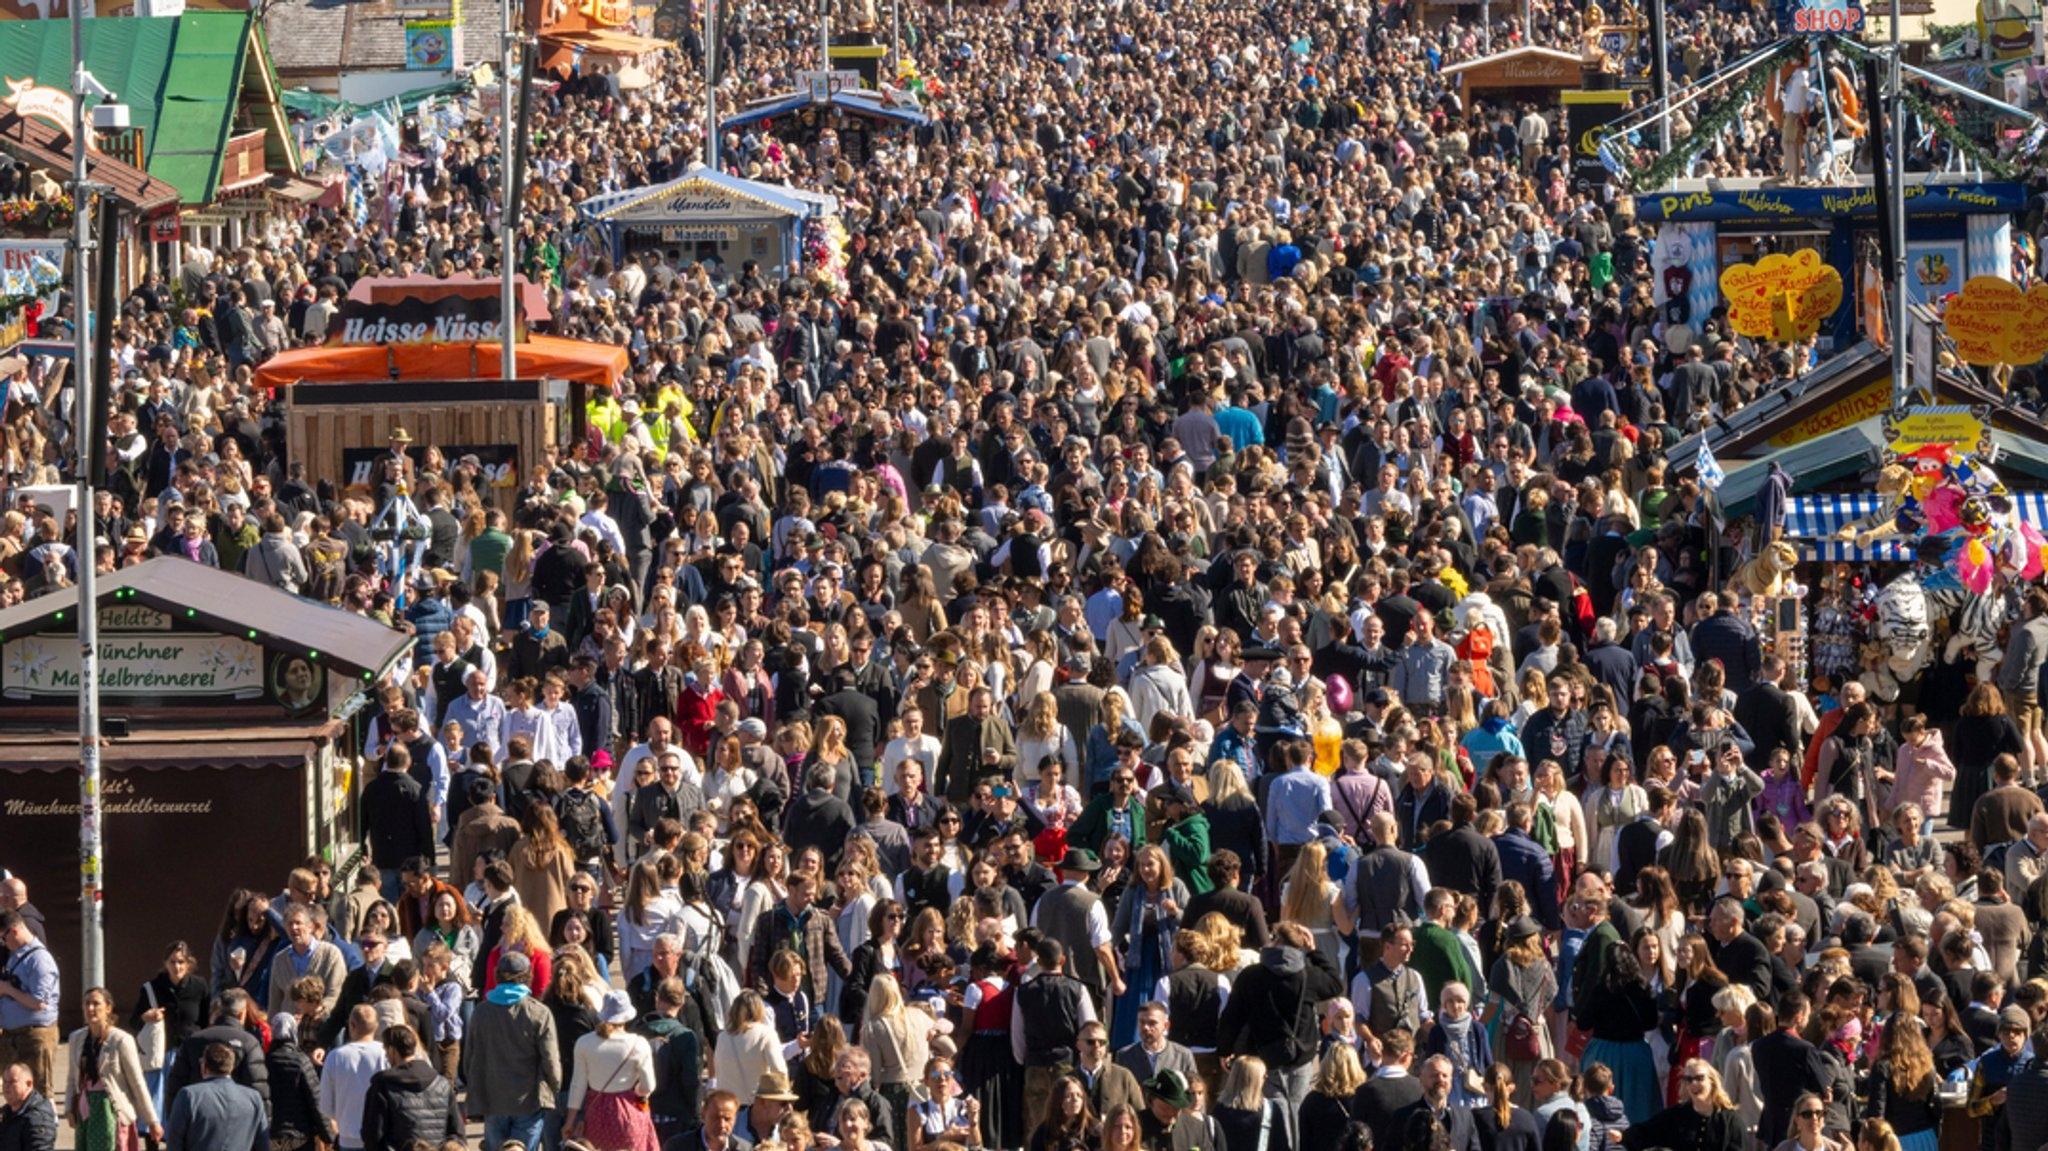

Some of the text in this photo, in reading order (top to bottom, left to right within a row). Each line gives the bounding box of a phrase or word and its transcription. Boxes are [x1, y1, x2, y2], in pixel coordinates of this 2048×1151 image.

[1794, 8, 1861, 32] SHOP
[666, 198, 732, 214] Mandeln
[1660, 191, 1713, 219] Pins
[1947, 187, 1997, 206] Tassen
[674, 229, 728, 241] Mandeln
[342, 316, 428, 344] Heisse
[99, 608, 163, 626] Heldt's
[51, 667, 216, 687] Madelbrennerei
[100, 798, 212, 815] andelbrennerei
